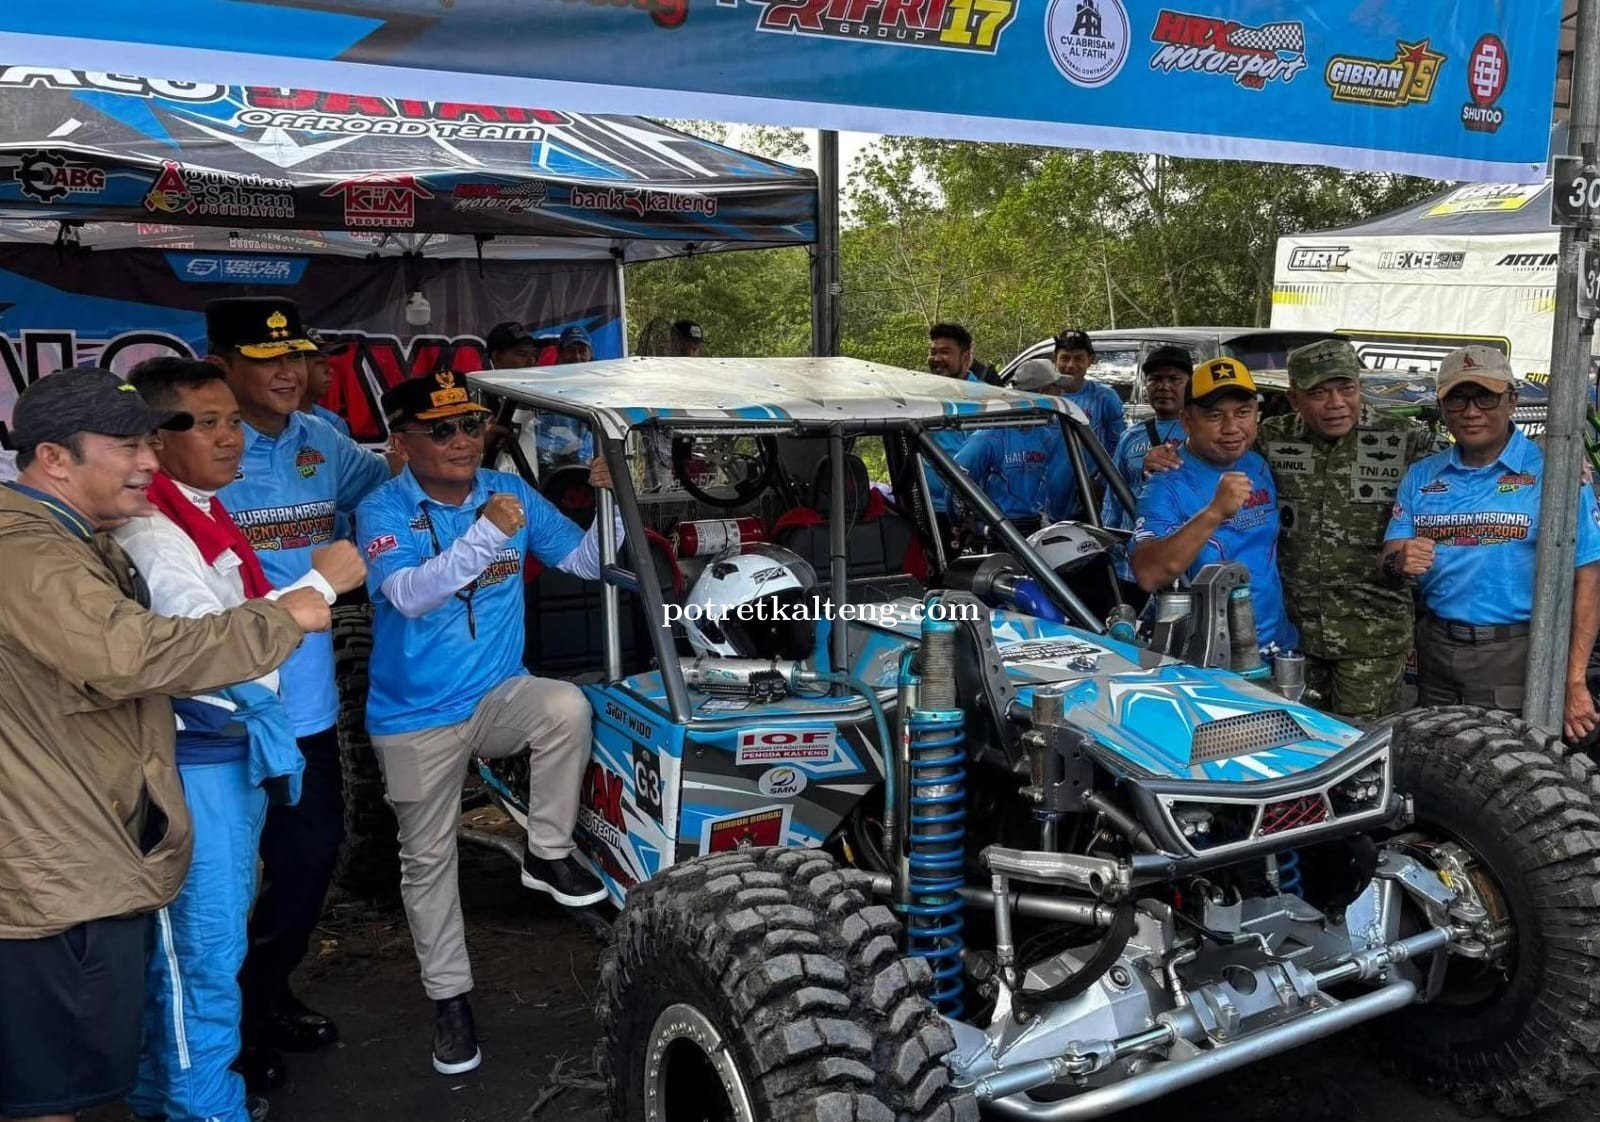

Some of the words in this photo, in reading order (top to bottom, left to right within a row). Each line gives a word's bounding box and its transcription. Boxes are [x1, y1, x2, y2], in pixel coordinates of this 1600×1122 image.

[839, 23, 926, 41] GROUP
[1153, 11, 1241, 52] HRX
[1075, 38, 1116, 51] ABRISAM
[1069, 46, 1080, 57] AL
[1082, 48, 1107, 60] FATIH
[1330, 61, 1404, 89] GIBRAN
[1339, 84, 1372, 97] RACING
[1373, 88, 1397, 99] TEAM
[1462, 105, 1503, 124] SHUTOO
[240, 110, 429, 136] OFFROAD
[436, 122, 544, 141] TEAM
[54, 166, 106, 189] ABG
[203, 186, 295, 208] Sabran
[571, 186, 623, 209] bank
[644, 190, 718, 218] kalteng
[200, 204, 296, 219] FOUNDATION
[345, 217, 415, 228] PROPERTY
[1360, 465, 1379, 477] TNI
[1381, 467, 1399, 478] AD
[1413, 514, 1474, 527] KEJUARAAN
[1475, 512, 1532, 526] NASIONAL
[1474, 525, 1527, 539] OFFROAD
[742, 732, 831, 747] IOF
[743, 751, 781, 759] PENGDA
[634, 760, 661, 807] G3
[769, 785, 798, 795] SMN
[592, 818, 621, 850] TEAM
